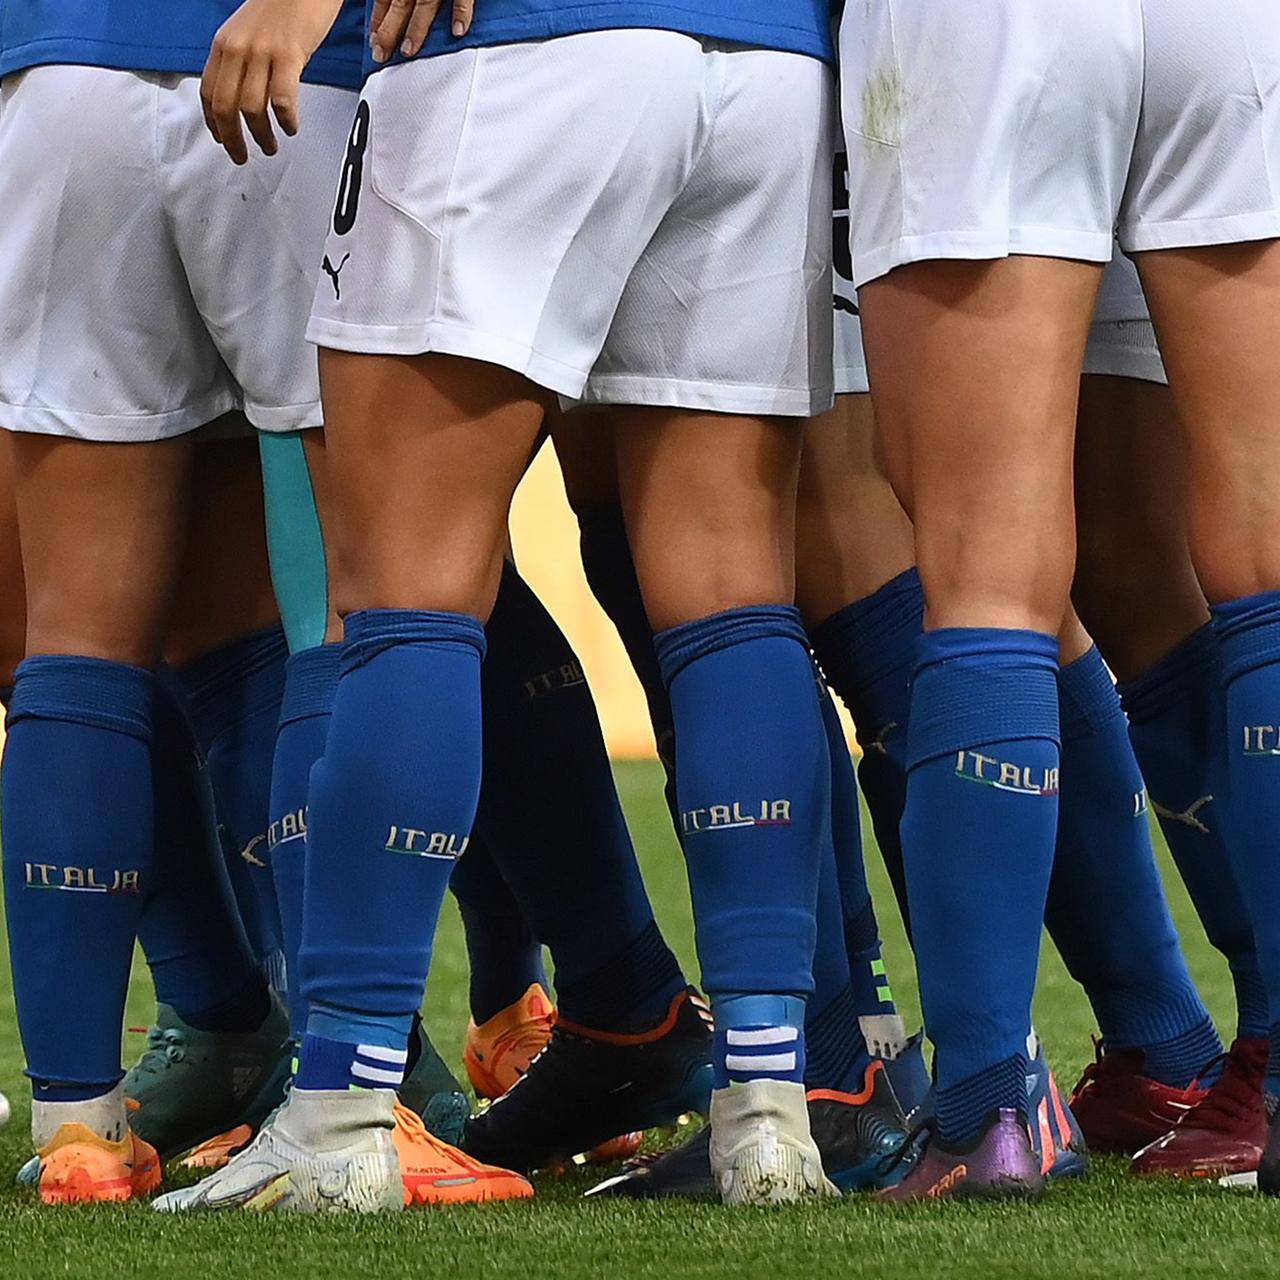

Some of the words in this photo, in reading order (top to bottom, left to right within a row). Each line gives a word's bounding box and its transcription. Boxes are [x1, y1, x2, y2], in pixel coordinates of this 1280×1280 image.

[955, 750, 1059, 792] ITALIA
[683, 800, 791, 832] ITALIA
[24, 862, 140, 890] ITALIA
